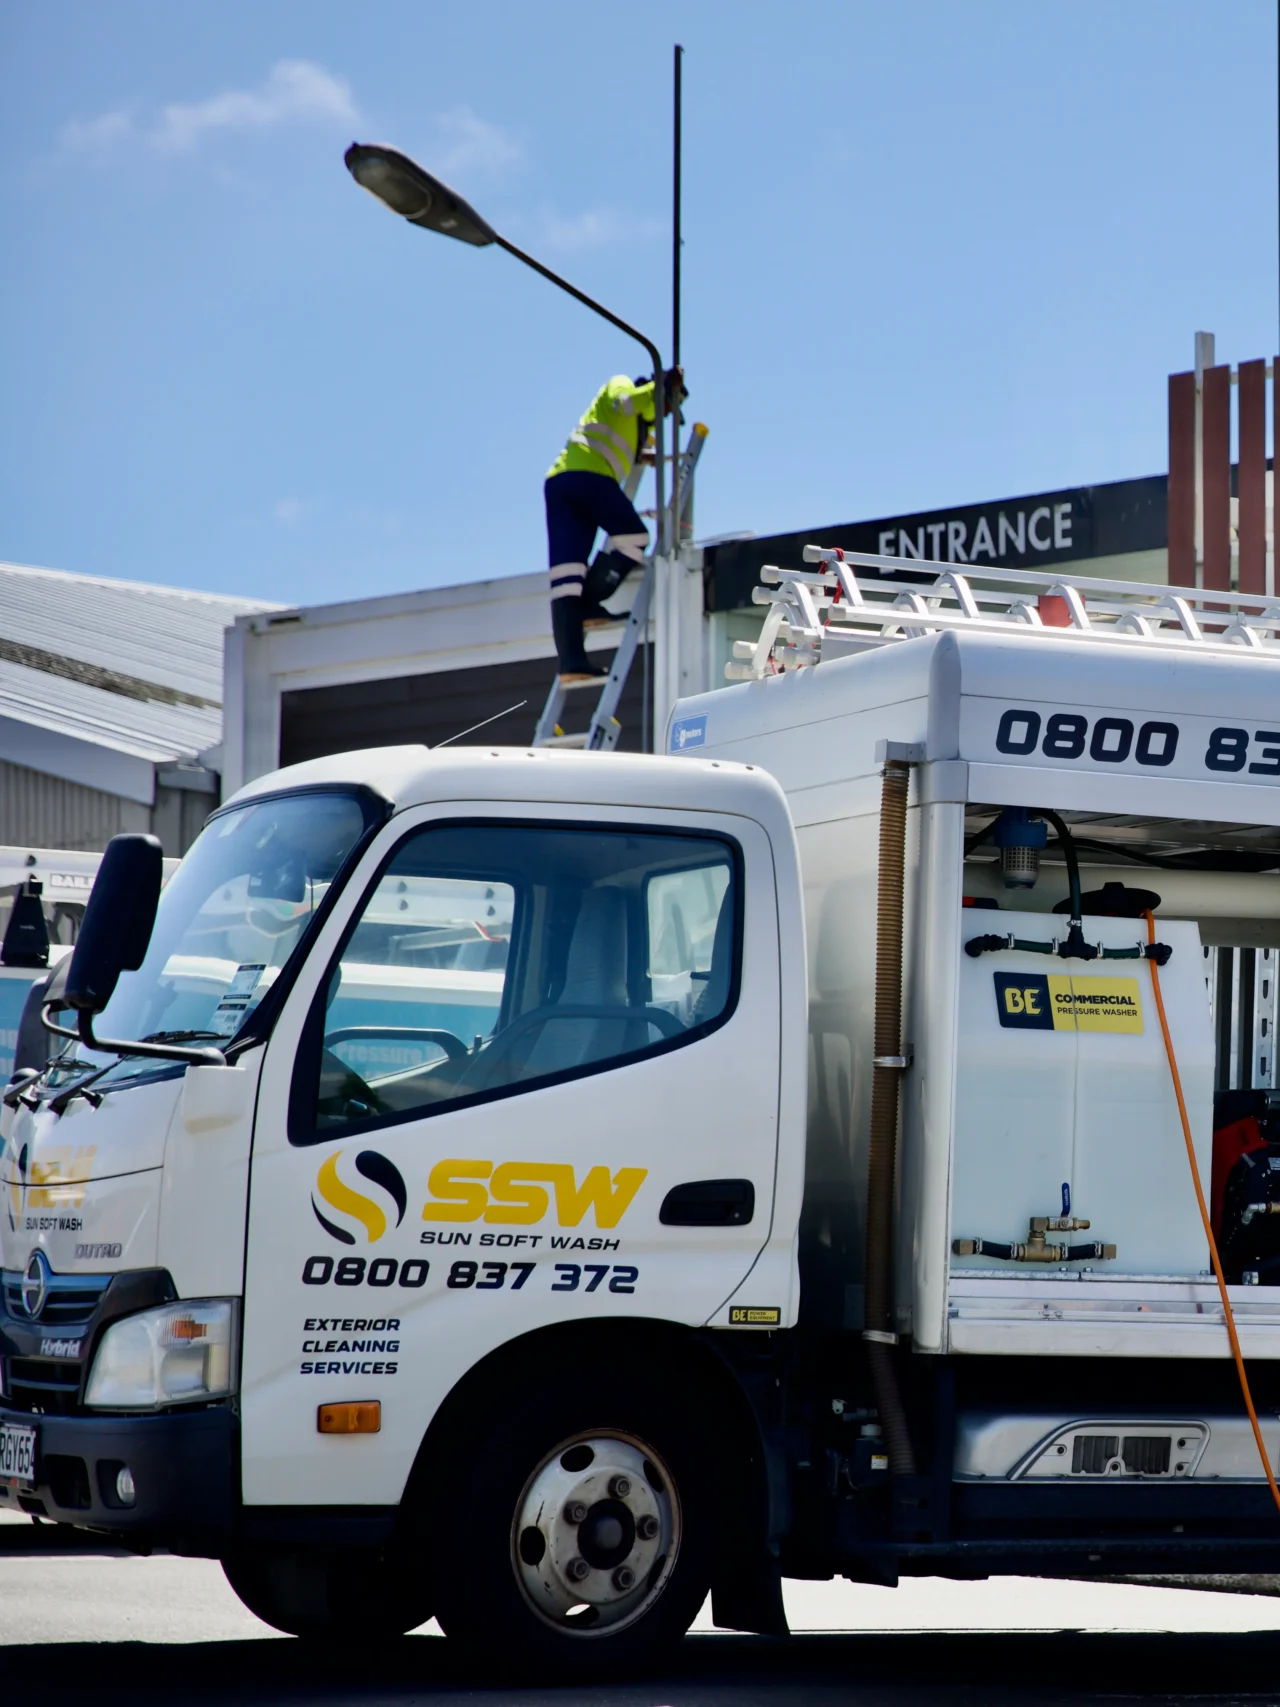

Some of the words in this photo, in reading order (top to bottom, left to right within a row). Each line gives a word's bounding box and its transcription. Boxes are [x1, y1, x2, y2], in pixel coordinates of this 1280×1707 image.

[879, 503, 1072, 574] ENTRANCE
[996, 709, 1180, 767] 0800
[1004, 987, 1042, 1015] BE
[1055, 994, 1136, 1005] COMMERCIAL
[1057, 1007, 1101, 1015] PRESSURE
[1102, 1008, 1137, 1016] WASHER
[421, 1159, 648, 1229] SSW
[26, 1217, 38, 1230] SUN
[39, 1217, 58, 1230] SOFT
[59, 1217, 83, 1231] WASH
[420, 1231, 472, 1246] SUN
[479, 1233, 543, 1249] SOFT
[550, 1236, 621, 1251] WASH
[74, 1243, 123, 1259] DUTRO
[302, 1256, 430, 1288] 0800
[447, 1261, 537, 1290] 837
[551, 1264, 639, 1294] 372
[732, 1309, 747, 1321] BE
[303, 1318, 400, 1331] EXTERIOR
[40, 1338, 82, 1358] Hybrid
[302, 1340, 400, 1353] CLEANING
[300, 1361, 398, 1375] SERVICES
